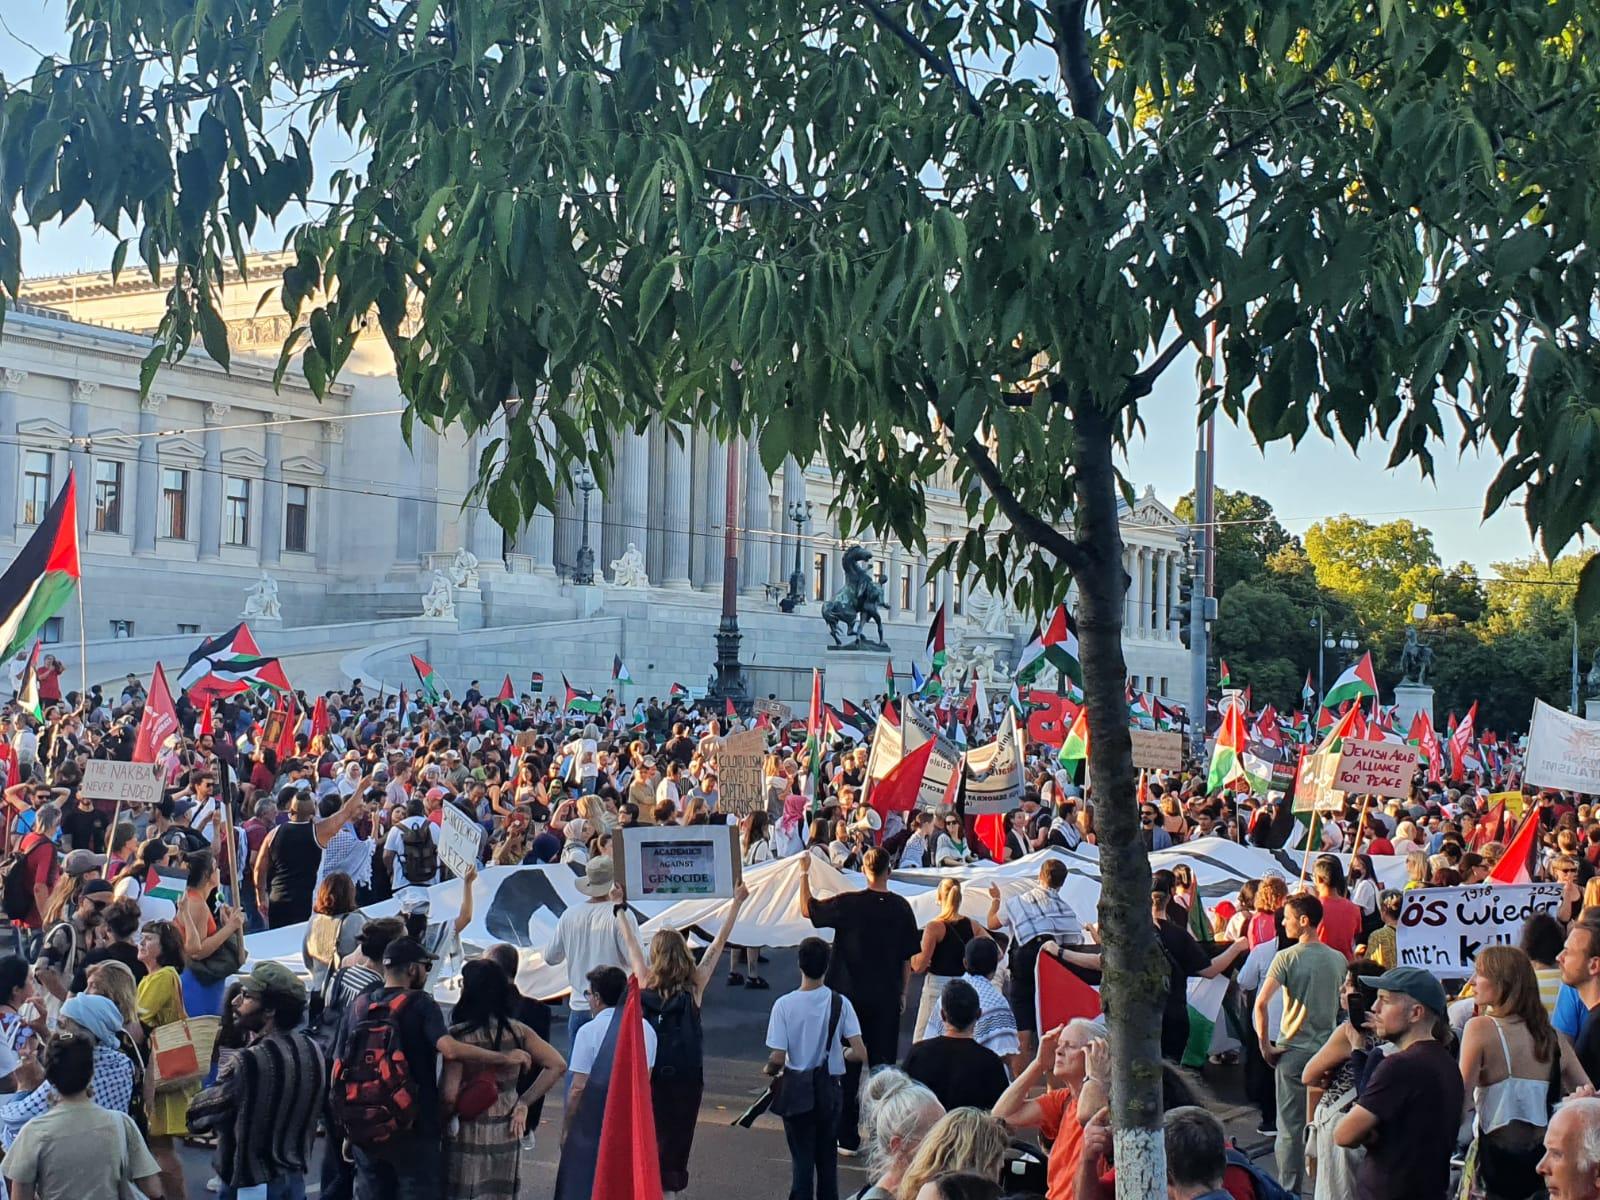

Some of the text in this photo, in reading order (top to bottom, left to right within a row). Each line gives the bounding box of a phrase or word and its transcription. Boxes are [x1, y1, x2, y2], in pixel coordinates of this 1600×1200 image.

[1342, 743, 1388, 760] JEWISH
[91, 762, 151, 781] THE NAKBA
[1353, 760, 1401, 774] ALLIANCE
[1340, 772, 1403, 789] FOR PEACE
[86, 780, 154, 799] NEVER ENDED
[660, 860, 694, 869] AGAINST
[648, 873, 709, 884] GENOCIDE
[1461, 886, 1563, 902] 1938 2025
